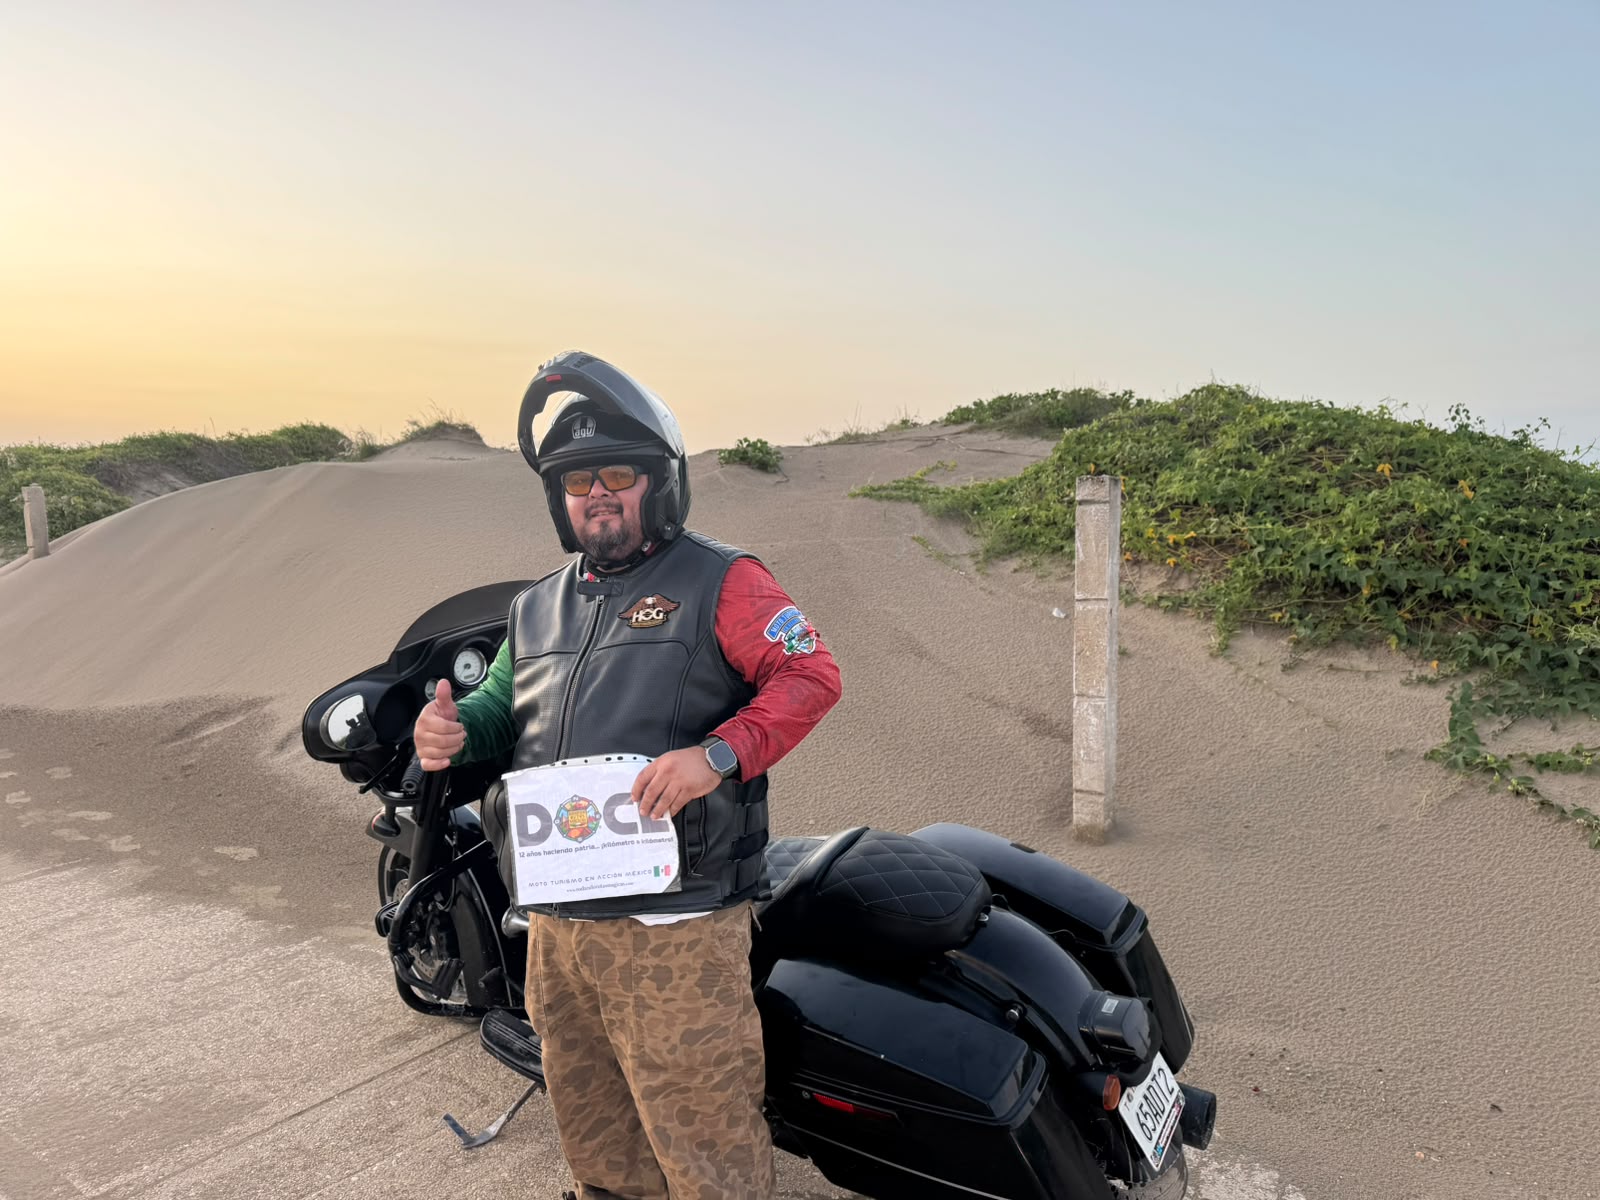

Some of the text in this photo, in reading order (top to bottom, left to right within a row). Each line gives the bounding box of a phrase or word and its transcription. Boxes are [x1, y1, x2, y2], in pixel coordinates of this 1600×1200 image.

[632, 607, 664, 622] HOG
[526, 850, 542, 858] años
[543, 847, 573, 856] haciendo
[551, 877, 582, 885] TURISMO
[1136, 1068, 1175, 1141] 65ADT2
